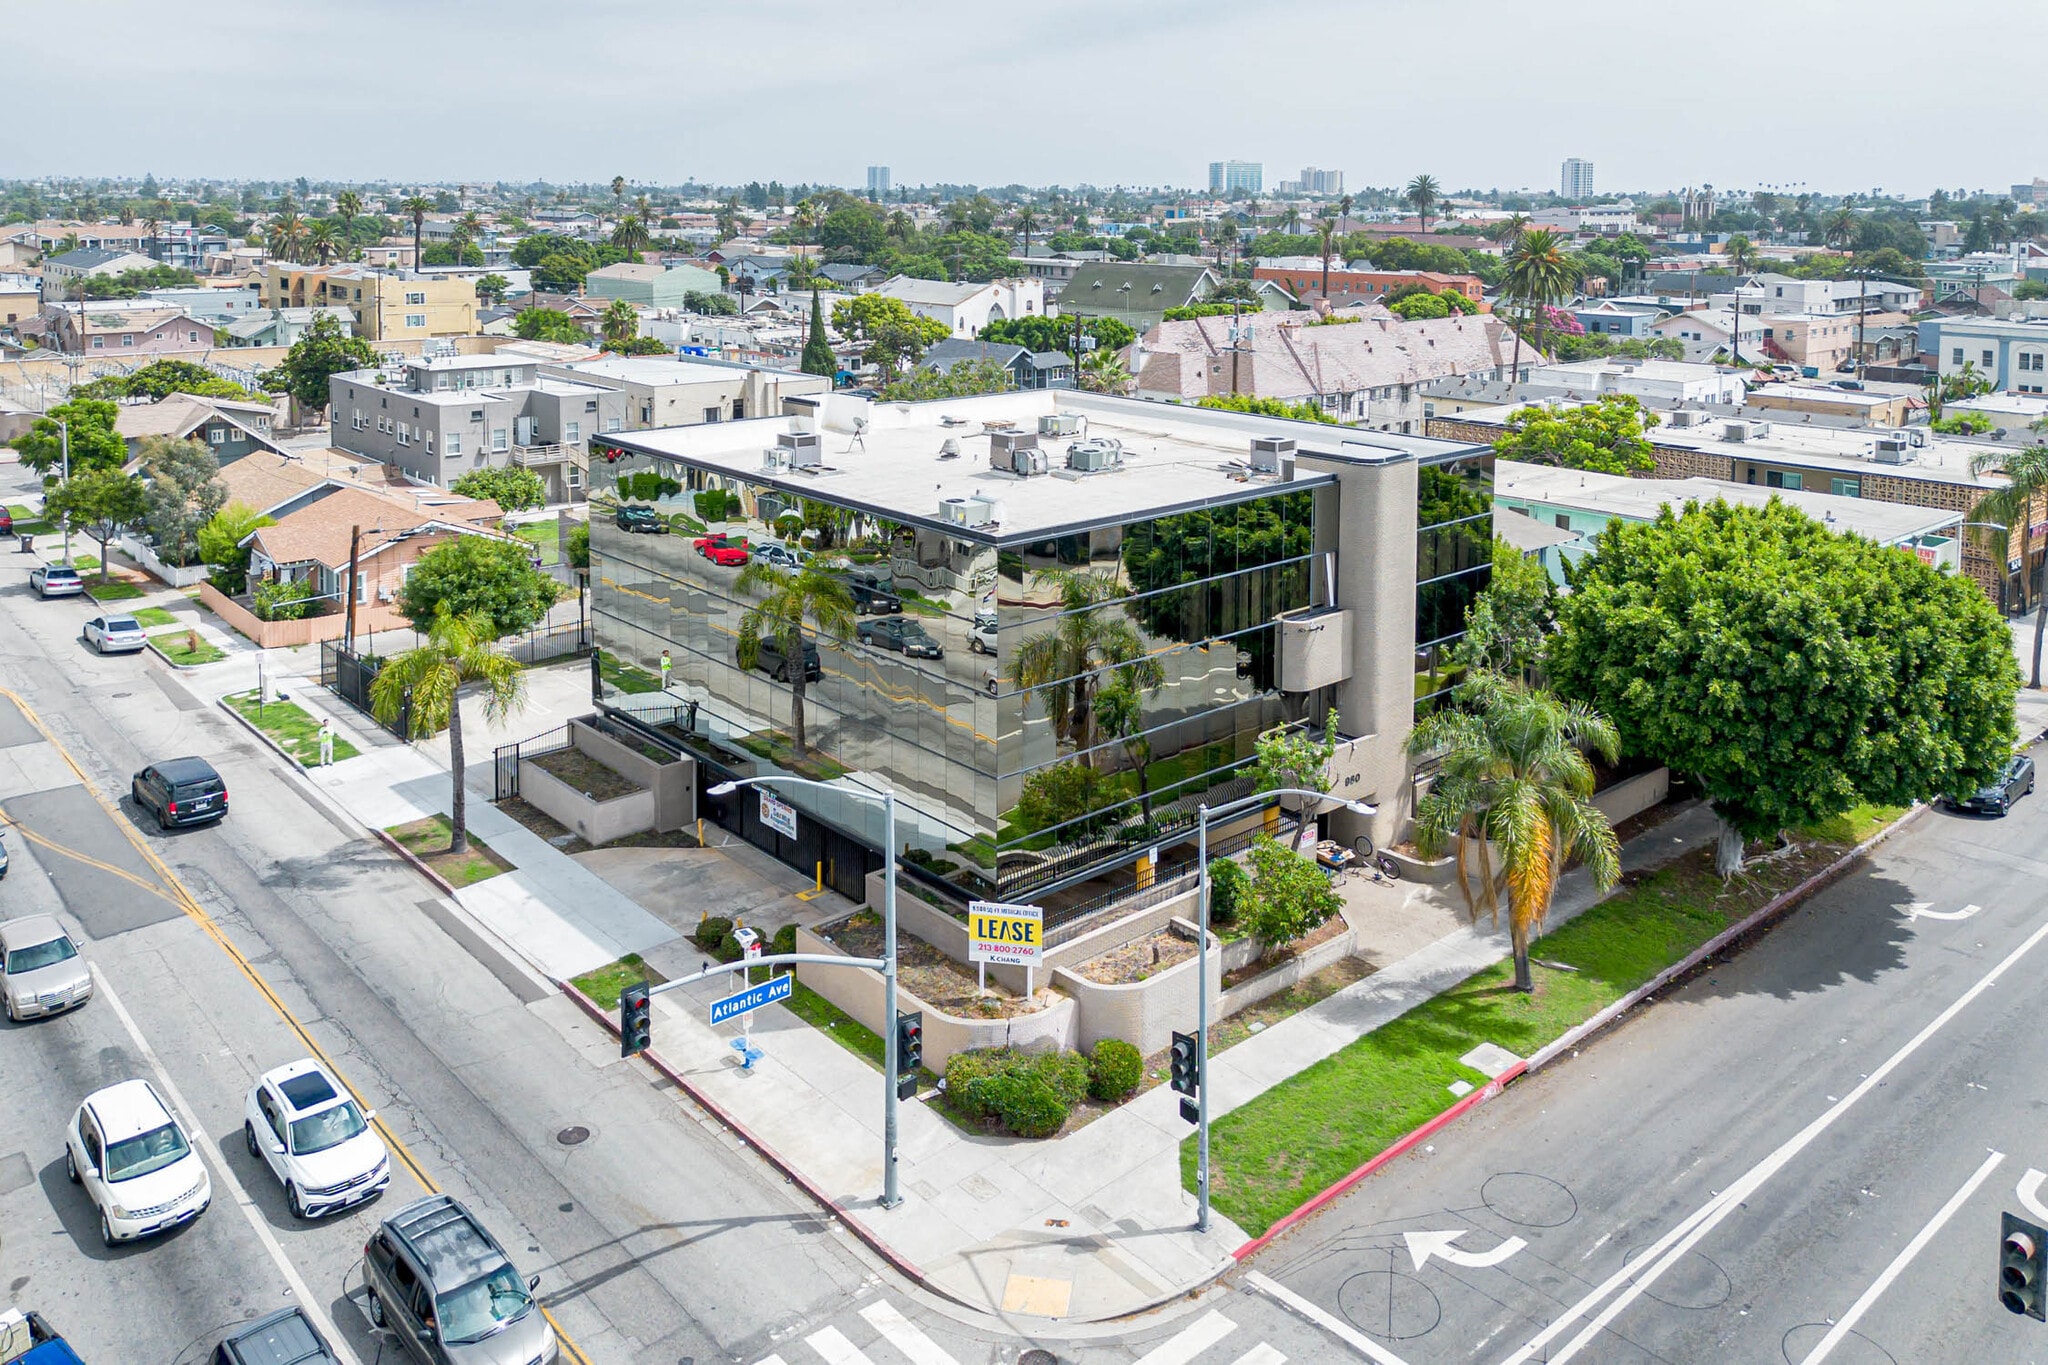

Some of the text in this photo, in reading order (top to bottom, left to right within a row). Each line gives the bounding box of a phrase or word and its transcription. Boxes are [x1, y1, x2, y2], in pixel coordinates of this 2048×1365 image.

[978, 918, 1034, 942] LEASE
[714, 983, 789, 1019] Atlantic Ave
